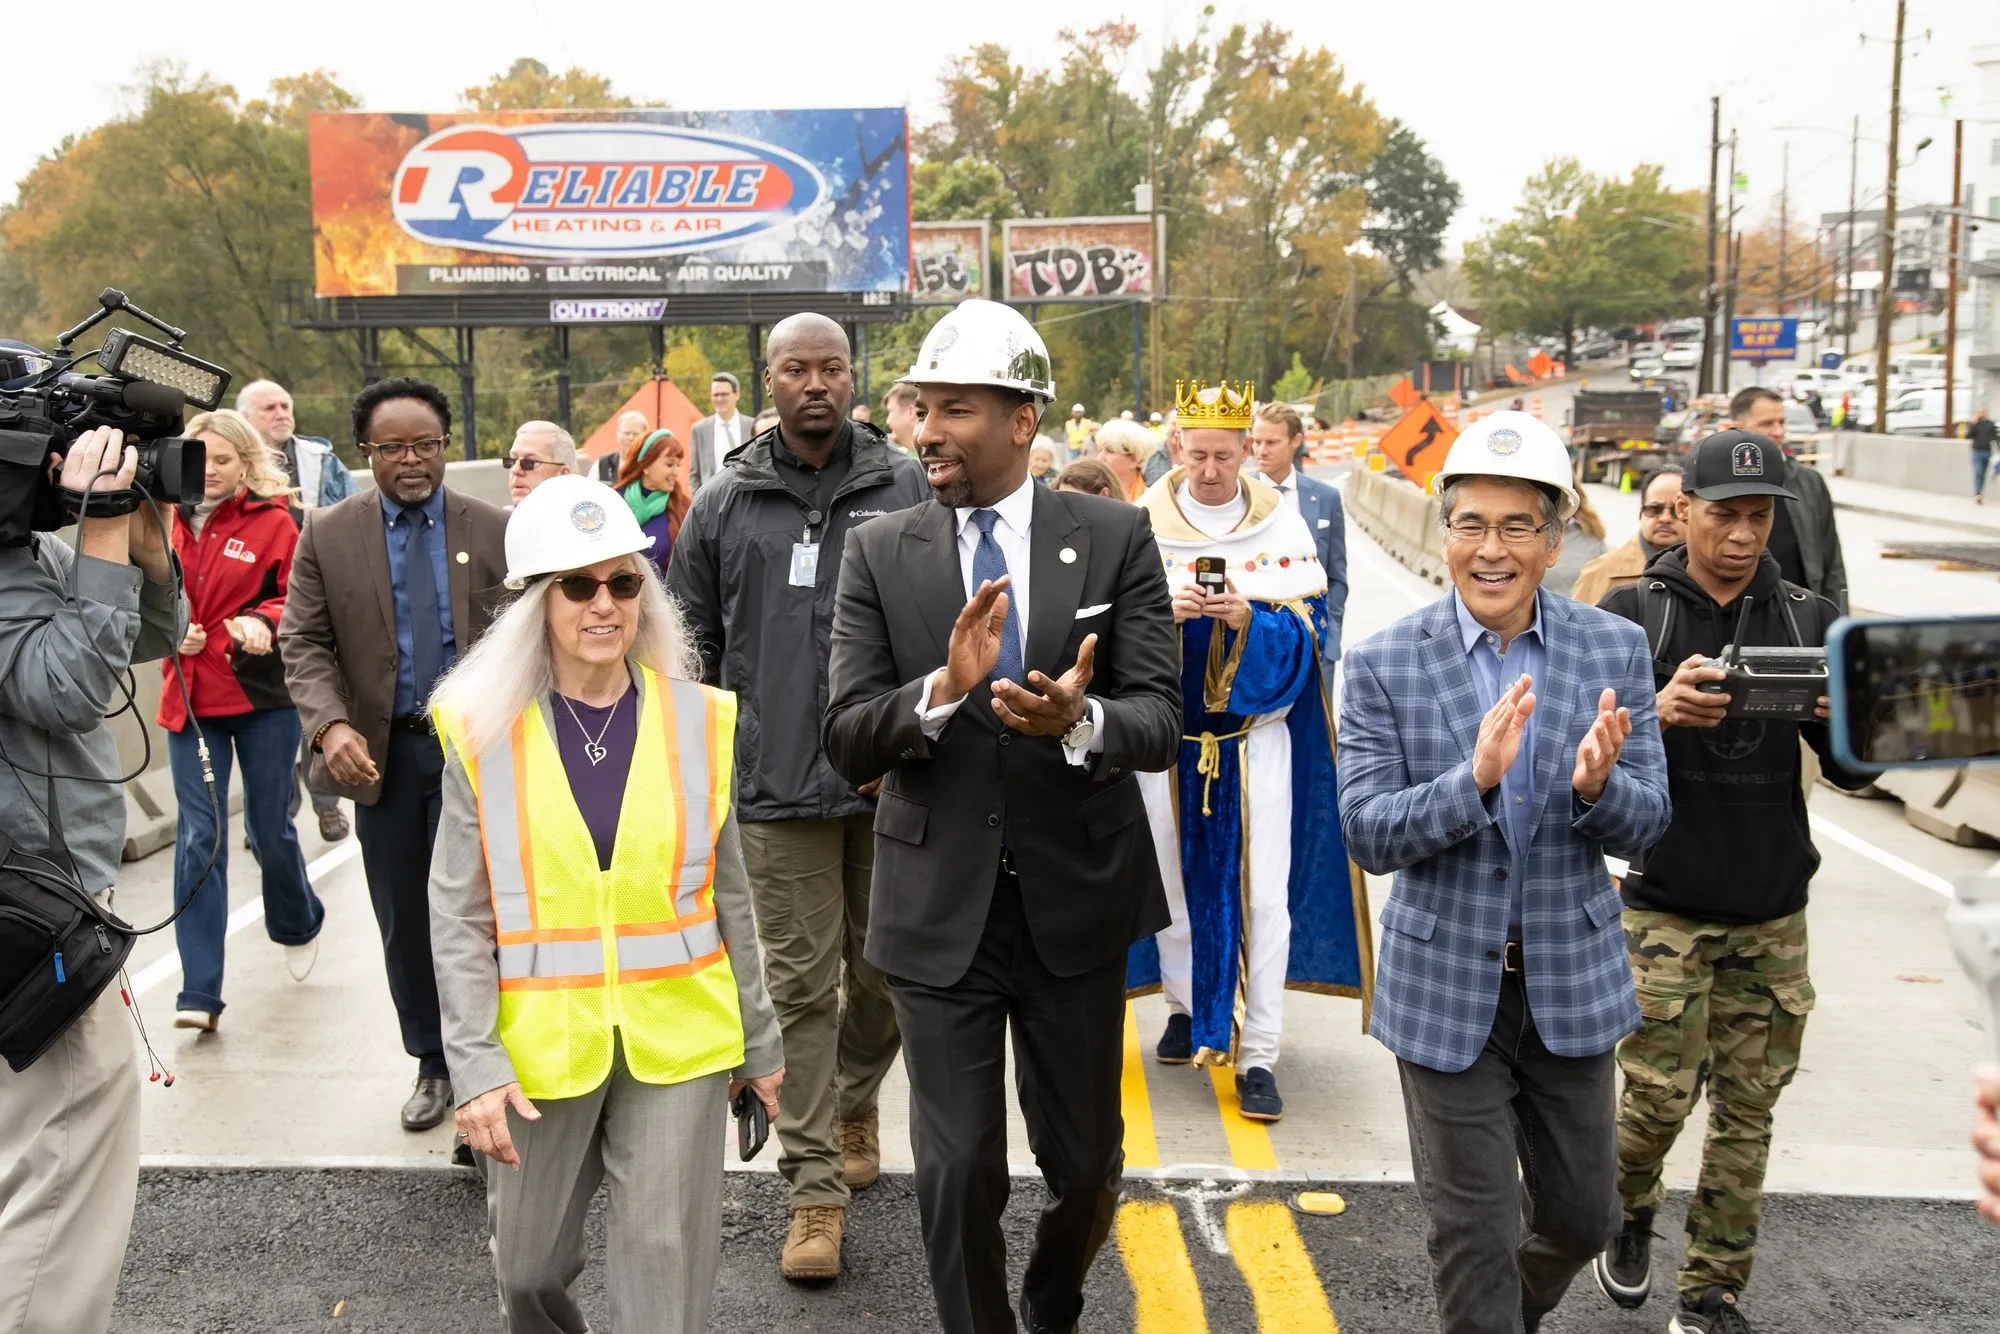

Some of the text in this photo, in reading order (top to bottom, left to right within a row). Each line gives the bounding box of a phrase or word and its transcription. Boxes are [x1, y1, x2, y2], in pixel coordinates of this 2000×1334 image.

[400, 150, 768, 220] RELIABLE
[512, 218, 722, 232] HEATING & AIR
[429, 264, 793, 283] PLUMBING ELECTRICAL AIR QUALITY
[1012, 248, 1126, 297] TDB
[555, 302, 663, 319] OUTFRONT
[856, 509, 887, 517] Columbia
